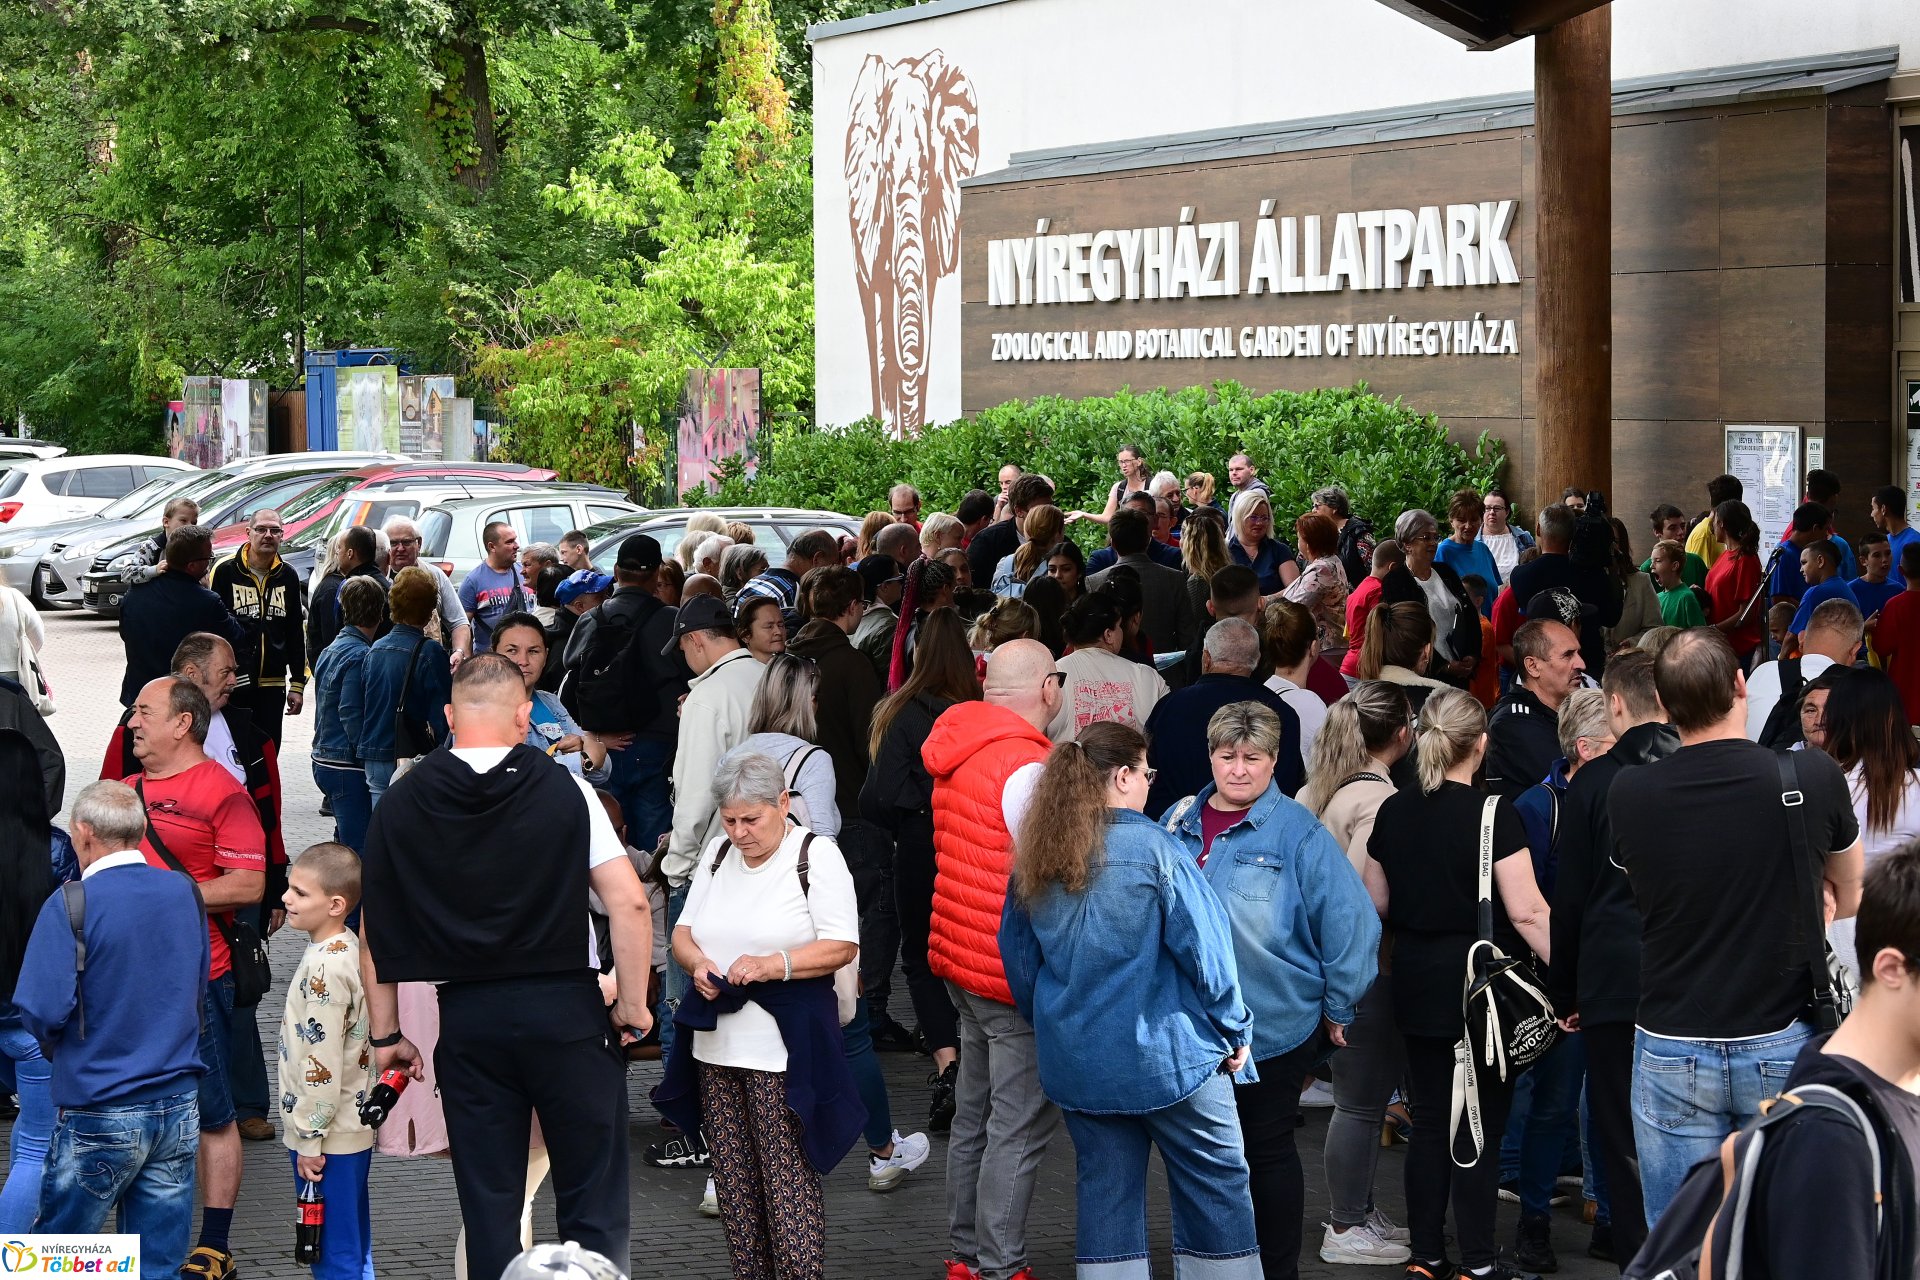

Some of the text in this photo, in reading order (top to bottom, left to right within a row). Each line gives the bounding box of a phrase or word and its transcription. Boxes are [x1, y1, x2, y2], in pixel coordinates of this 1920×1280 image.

[987, 199, 1520, 306] NYÍREGYHÁZI ÁLLATPARK
[991, 312, 1519, 361] ZOOLOGICAL AND BOTANICAL GARDEN OF NYÍREGYHÁZA
[1809, 443, 1820, 451] ATM
[1080, 686, 1098, 697] LATE
[1482, 845, 1490, 861] CHIX
[1508, 1037, 1536, 1057] MAYO
[1466, 1068, 1475, 1087] MAYO
[1470, 1105, 1478, 1121] BAG
[1472, 1120, 1482, 1136] CHIX
